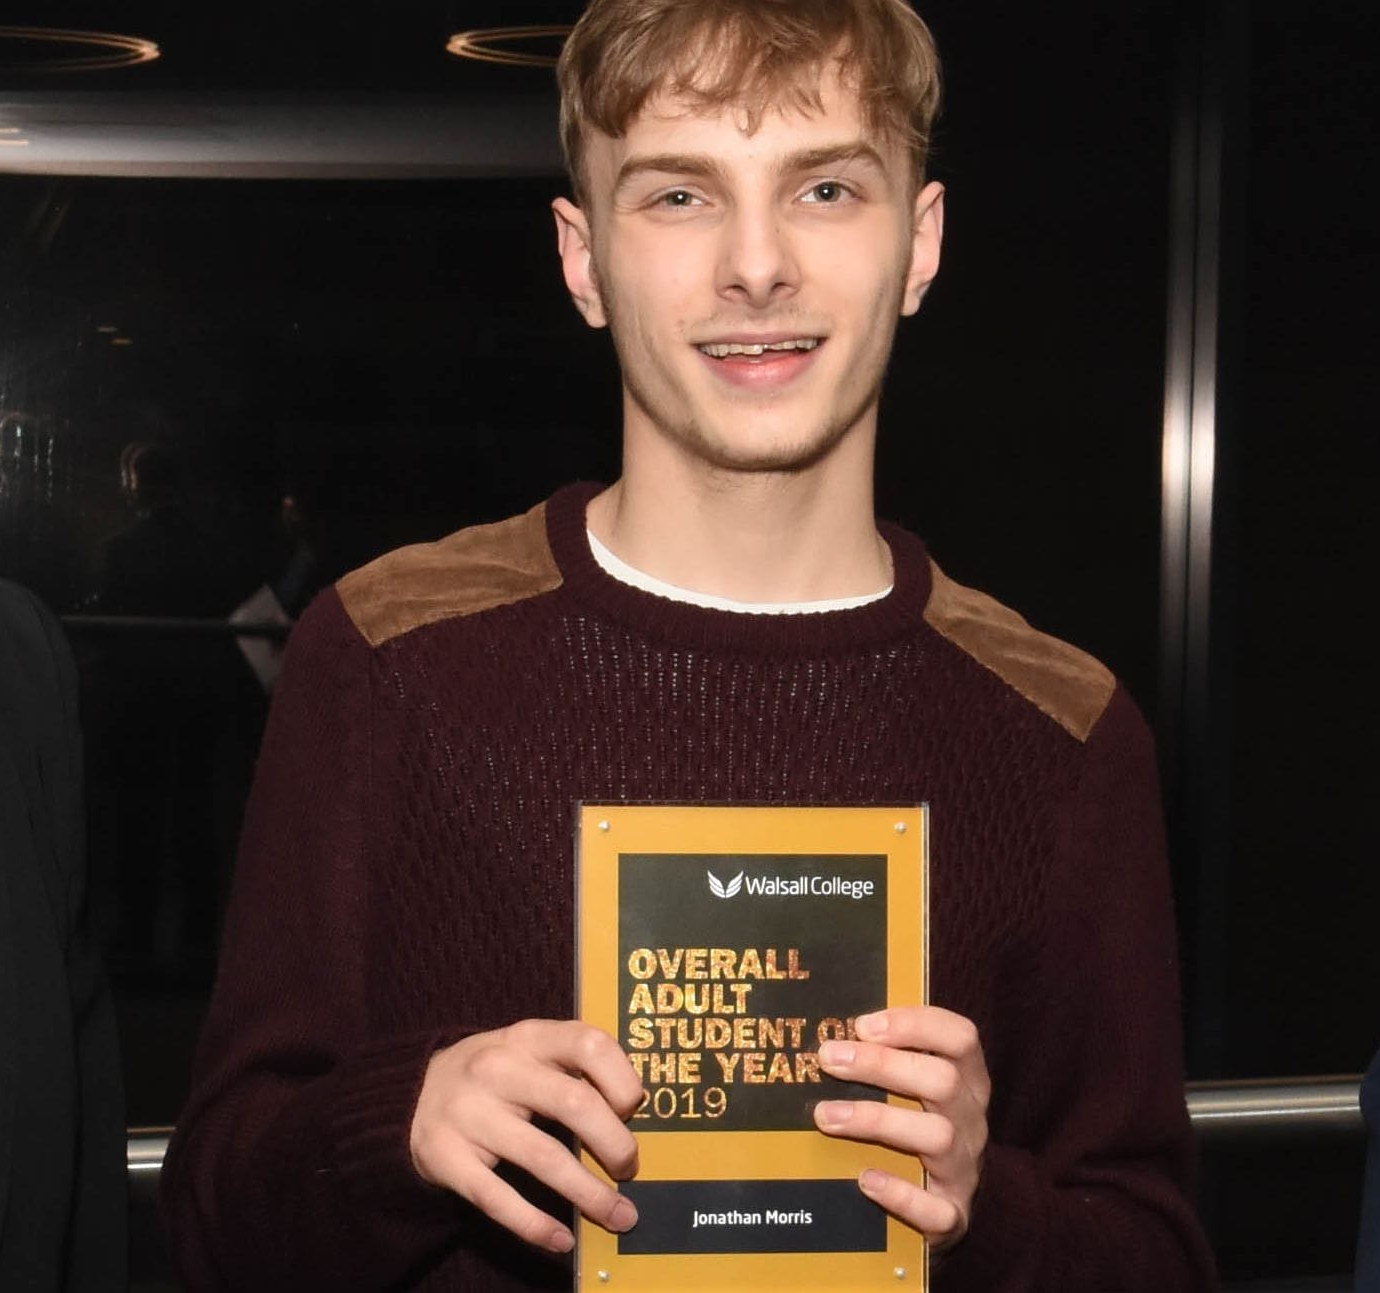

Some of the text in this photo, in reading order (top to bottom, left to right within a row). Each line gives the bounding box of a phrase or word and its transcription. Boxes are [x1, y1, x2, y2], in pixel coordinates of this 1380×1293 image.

[745, 875, 874, 899] Walsall College
[628, 948, 810, 980] OVERALL
[628, 983, 752, 1014] ADULT
[628, 1017, 806, 1049] STUDENT
[628, 1052, 821, 1083] THE YEAR
[633, 1087, 727, 1118] 2019
[693, 1210, 813, 1227] Jonathan Morris
